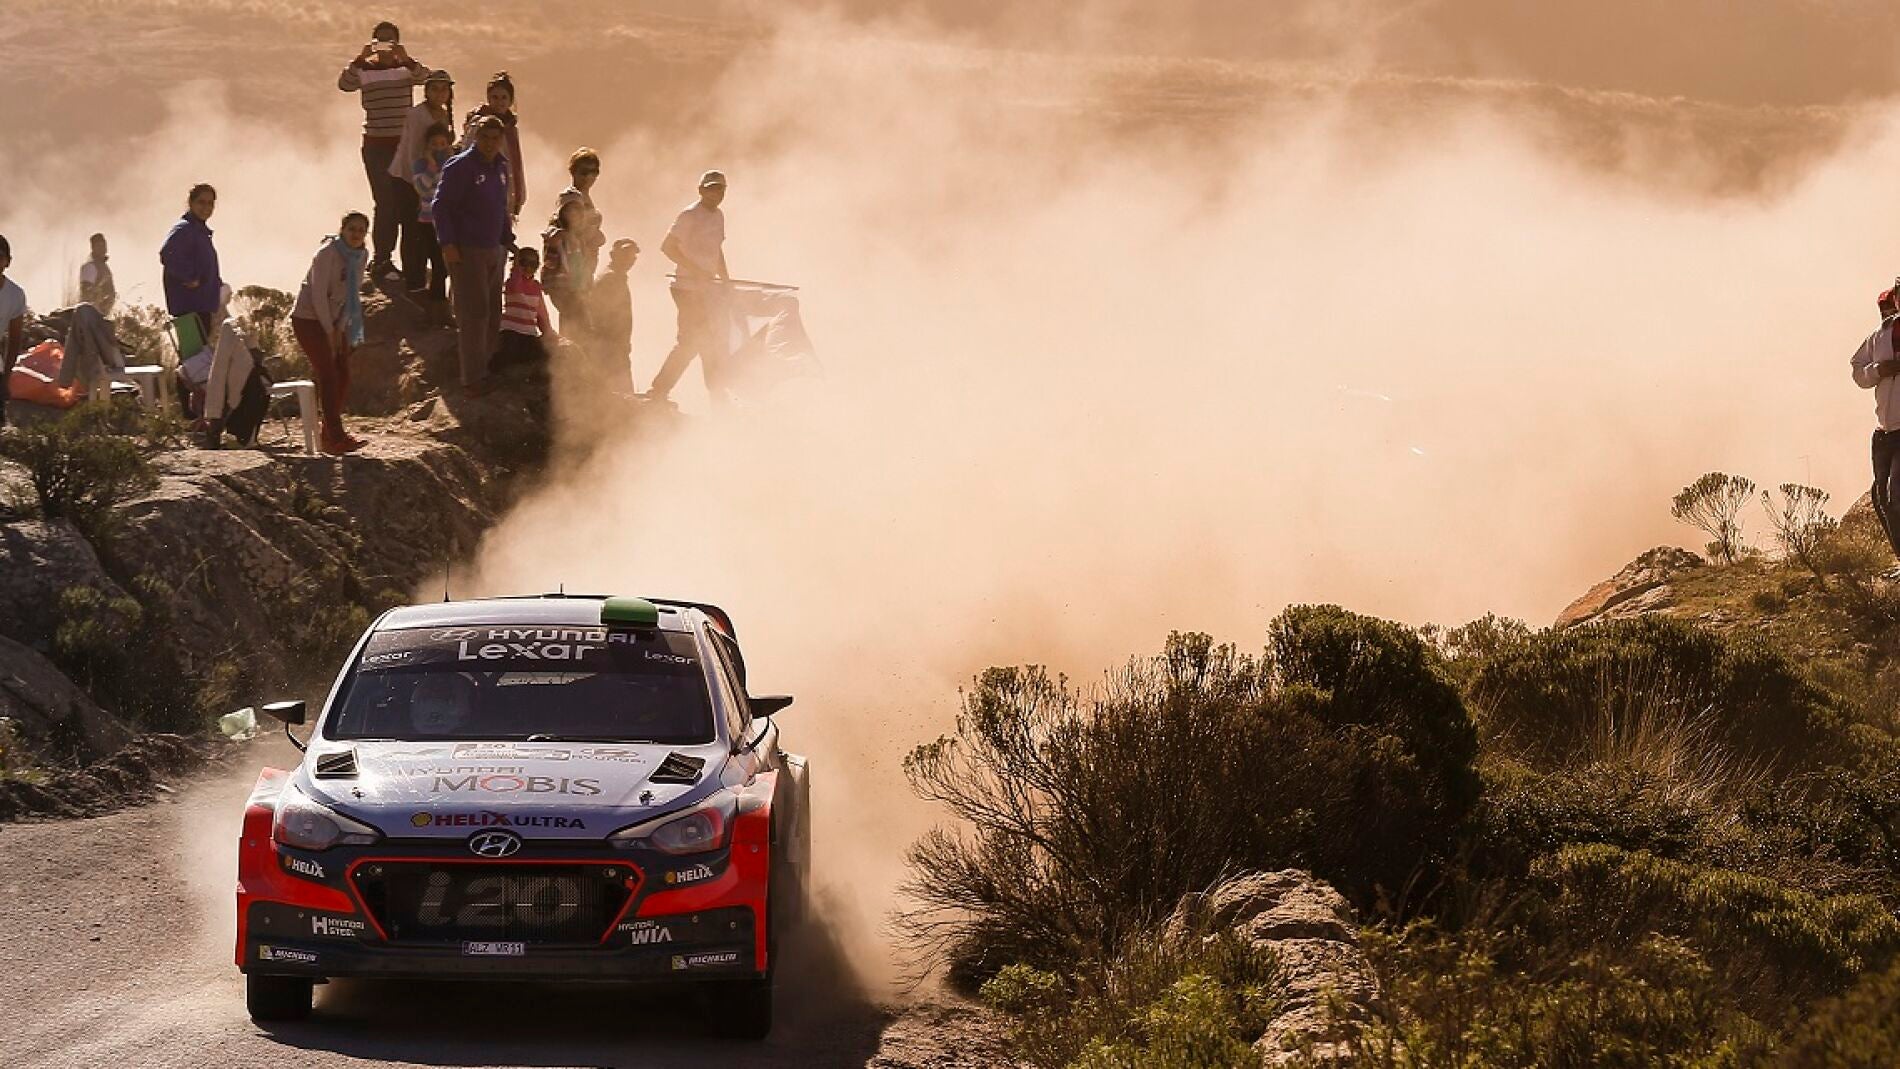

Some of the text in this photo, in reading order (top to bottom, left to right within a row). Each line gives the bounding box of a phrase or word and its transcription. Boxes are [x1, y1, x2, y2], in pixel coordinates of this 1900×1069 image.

[488, 630, 636, 644] HYUNDAI
[361, 651, 413, 664] Lexar
[458, 641, 595, 661] Lexar
[644, 650, 696, 665] Lexar
[430, 775, 602, 796] MOBIS
[434, 810, 586, 829] HELIX ULTRA
[291, 859, 325, 878] HELIX
[676, 863, 714, 883] HELIX
[417, 871, 579, 926] i20
[274, 950, 318, 961] MICHELIN
[688, 953, 737, 965] MICHELIN
